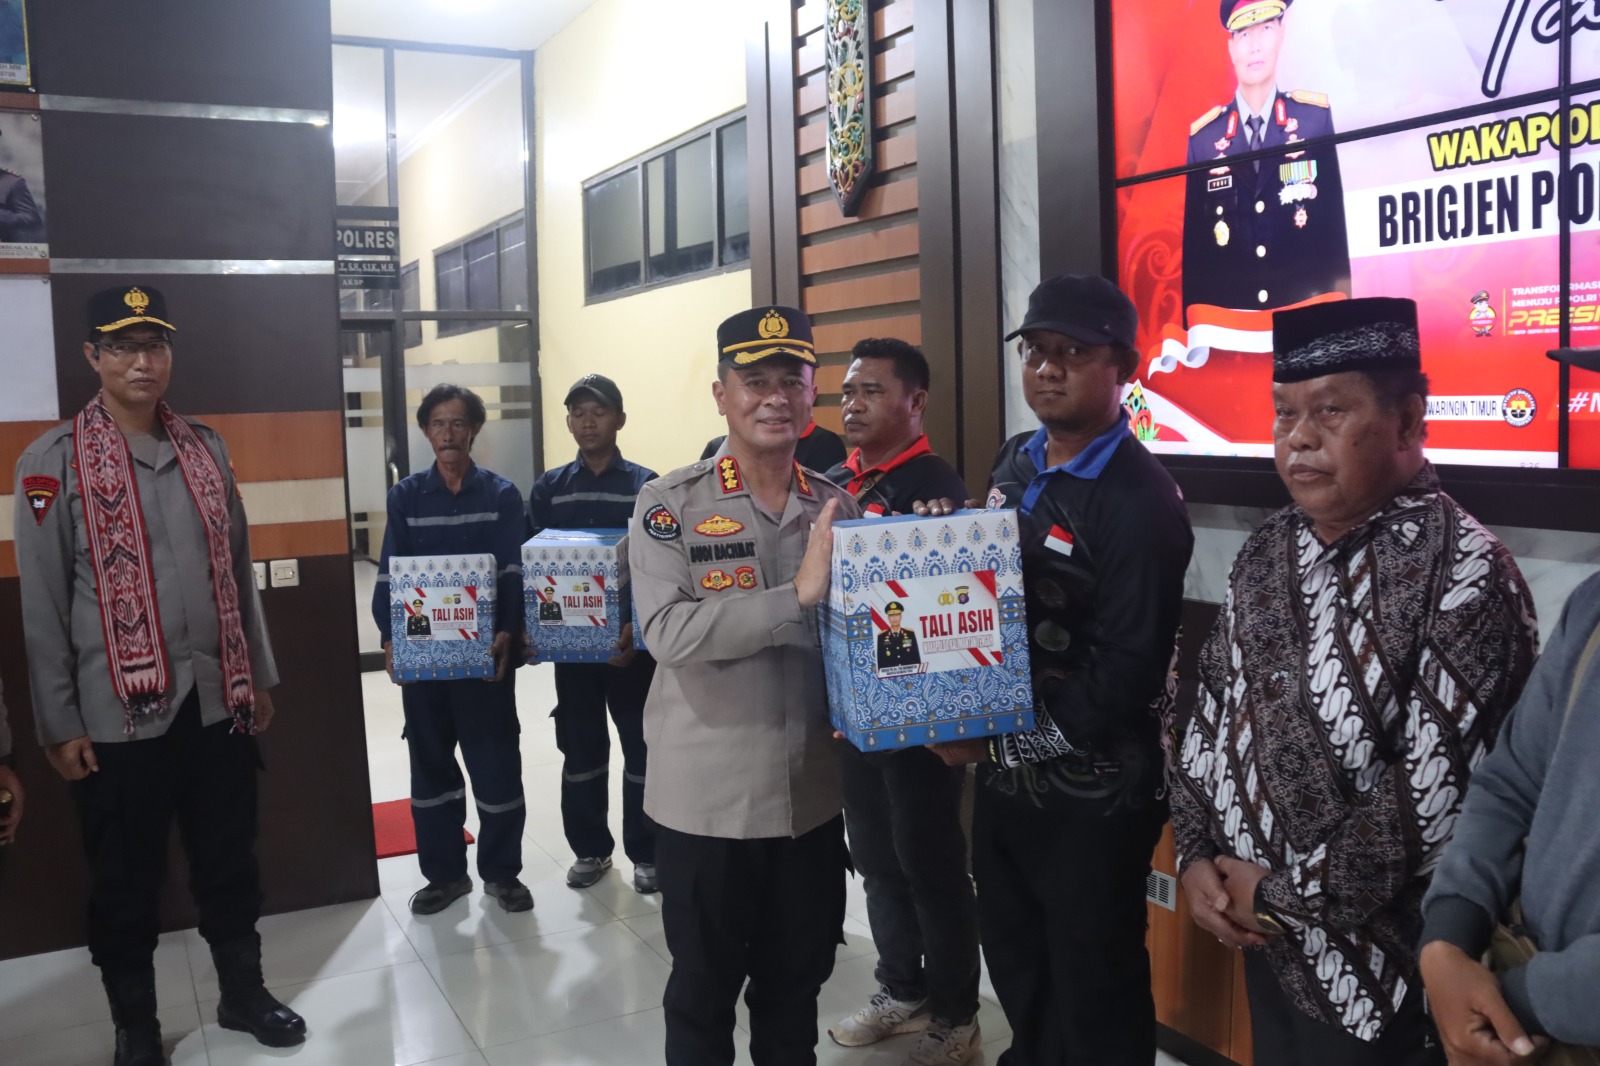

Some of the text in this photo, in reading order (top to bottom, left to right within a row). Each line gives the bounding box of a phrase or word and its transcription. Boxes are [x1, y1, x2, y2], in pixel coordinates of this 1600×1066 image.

[1378, 161, 1600, 248] BRIGJEN PO
[1511, 298, 1552, 308] MENUJU
[1470, 400, 1497, 416] TIMUR
[690, 544, 713, 563] BUDI
[562, 595, 603, 608] TALI ASIH
[431, 607, 474, 621] TALI ASIH
[919, 608, 994, 639] TALI ASIH
